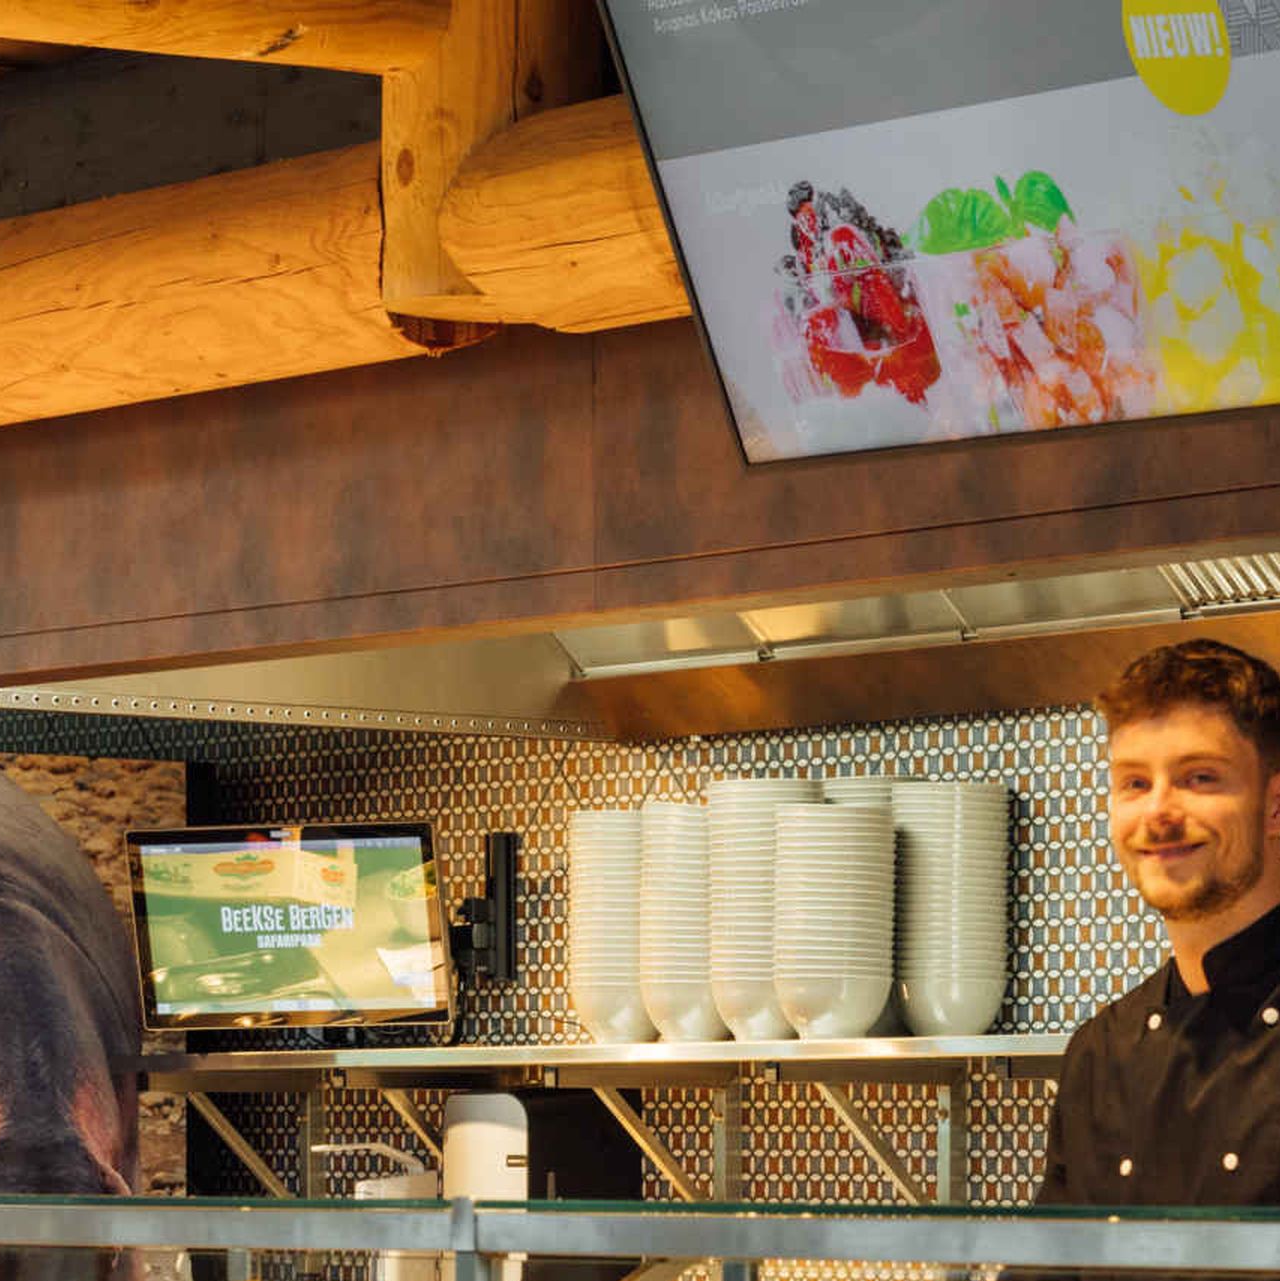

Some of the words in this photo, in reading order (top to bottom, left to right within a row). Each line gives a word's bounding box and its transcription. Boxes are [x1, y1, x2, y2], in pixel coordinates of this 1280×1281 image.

[1129, 12, 1224, 59] NIEUW!
[221, 904, 286, 932] BEEKSE
[288, 902, 354, 931] BERGEN
